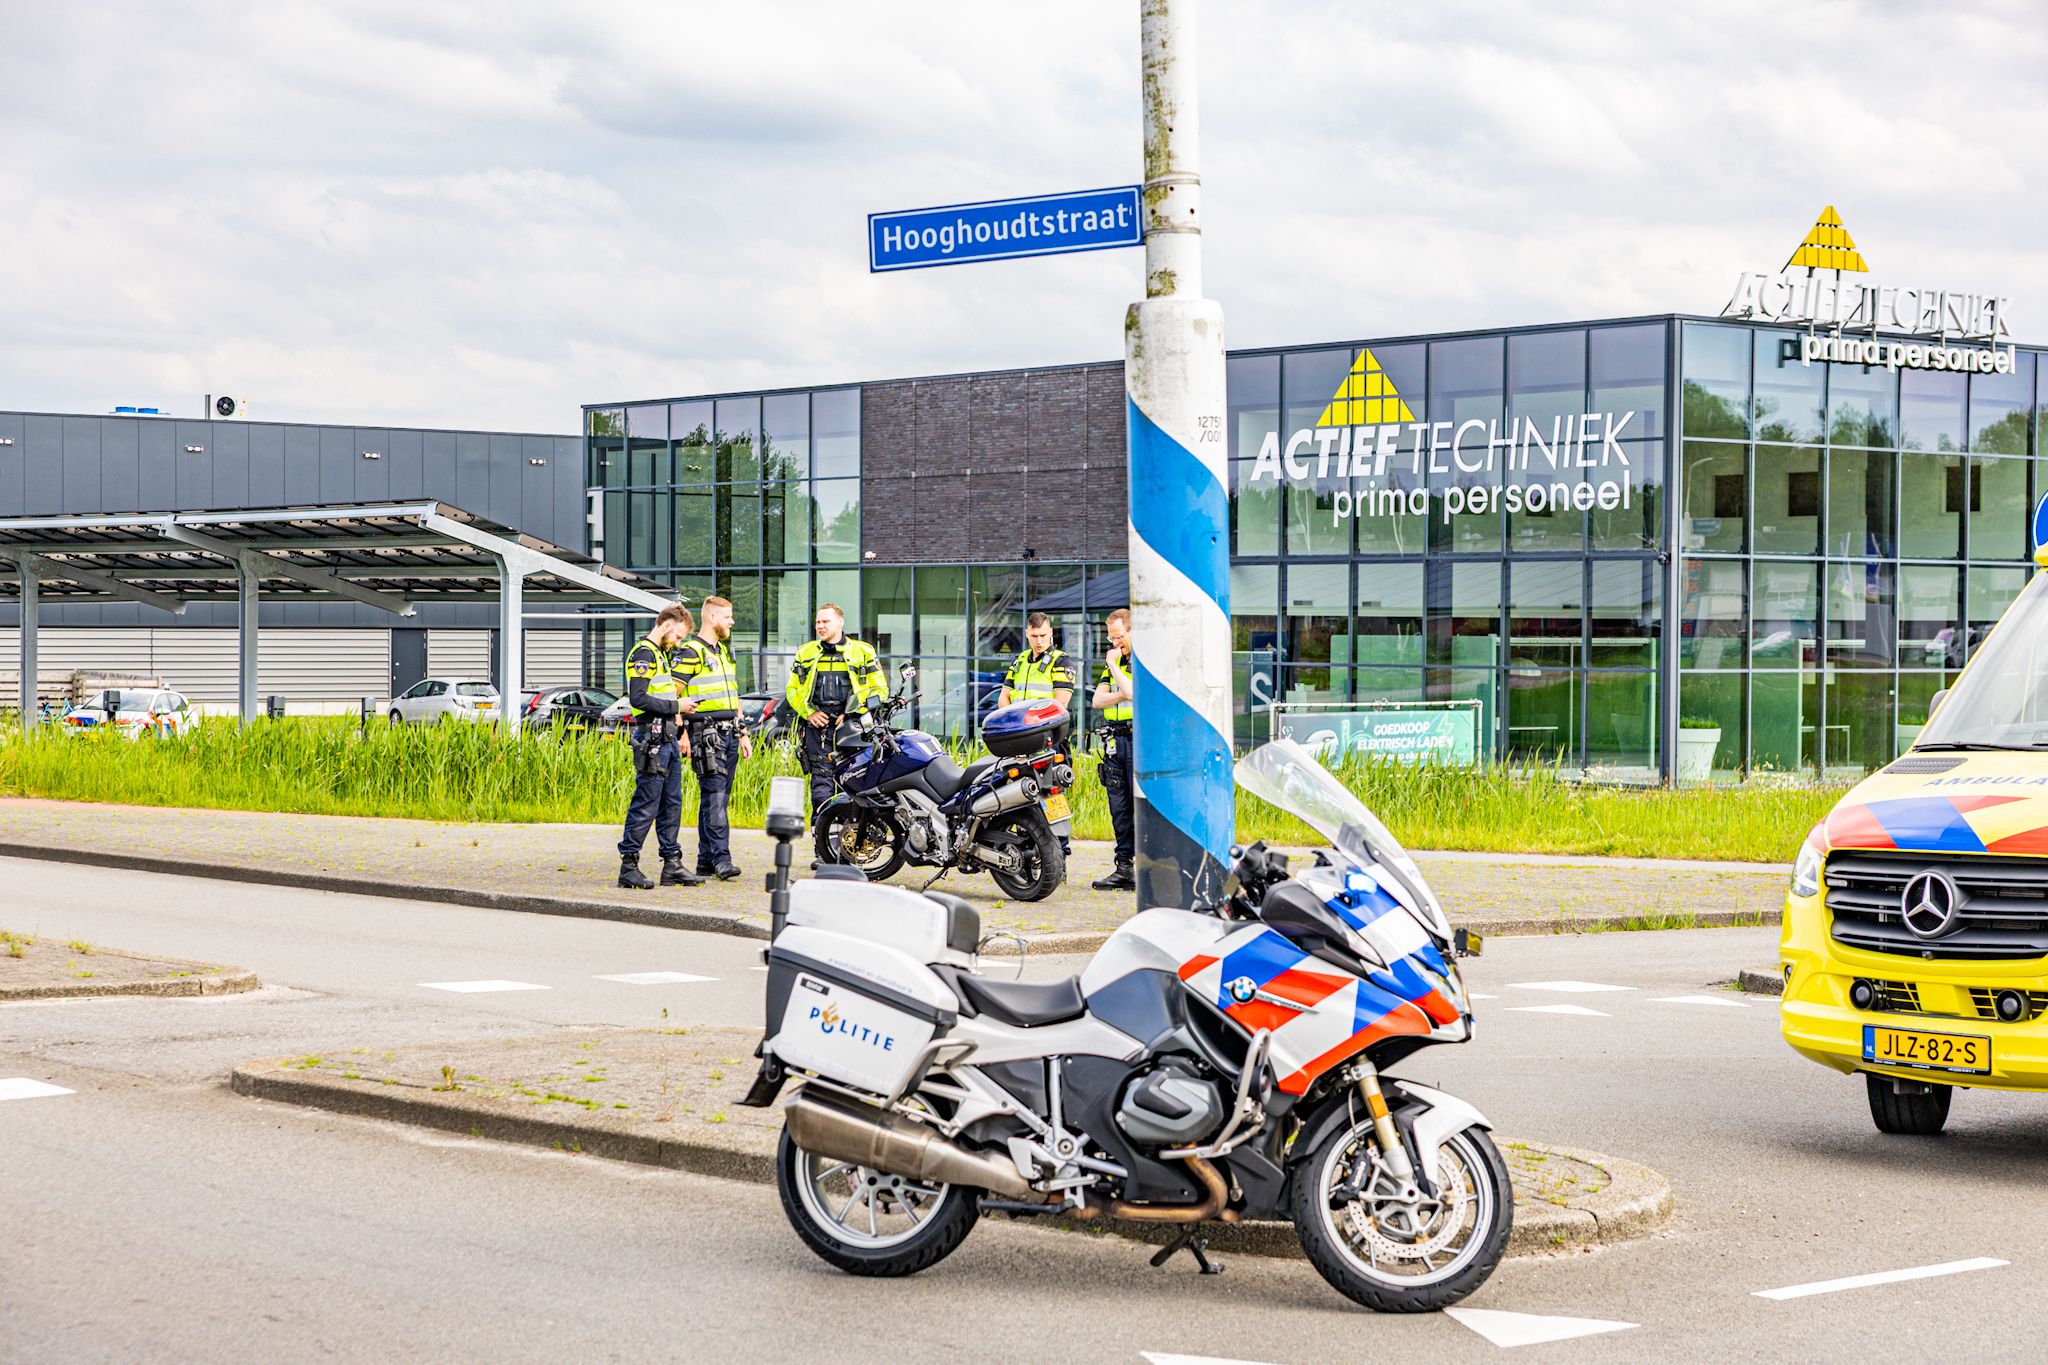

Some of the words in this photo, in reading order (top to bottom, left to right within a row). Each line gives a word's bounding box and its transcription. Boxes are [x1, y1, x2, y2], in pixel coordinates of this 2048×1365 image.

[882, 202, 1130, 254] Hooghoudtstraat
[1801, 330, 1881, 368] prima
[1887, 342, 2016, 375] personeel
[1249, 425, 1402, 482] ACTIEF
[1407, 410, 1637, 474] TECHNIEK
[1333, 480, 1430, 528] prima
[1443, 469, 1631, 525] personeel
[1356, 737, 1416, 751] ELEKTRISCH
[1416, 735, 1454, 749] LADEN
[1373, 721, 1431, 736] GOEDKOOP
[809, 1004, 895, 1052] POLITIE
[1865, 1045, 1875, 1053] NL
[1883, 1033, 1977, 1065] JLZ-82-S
